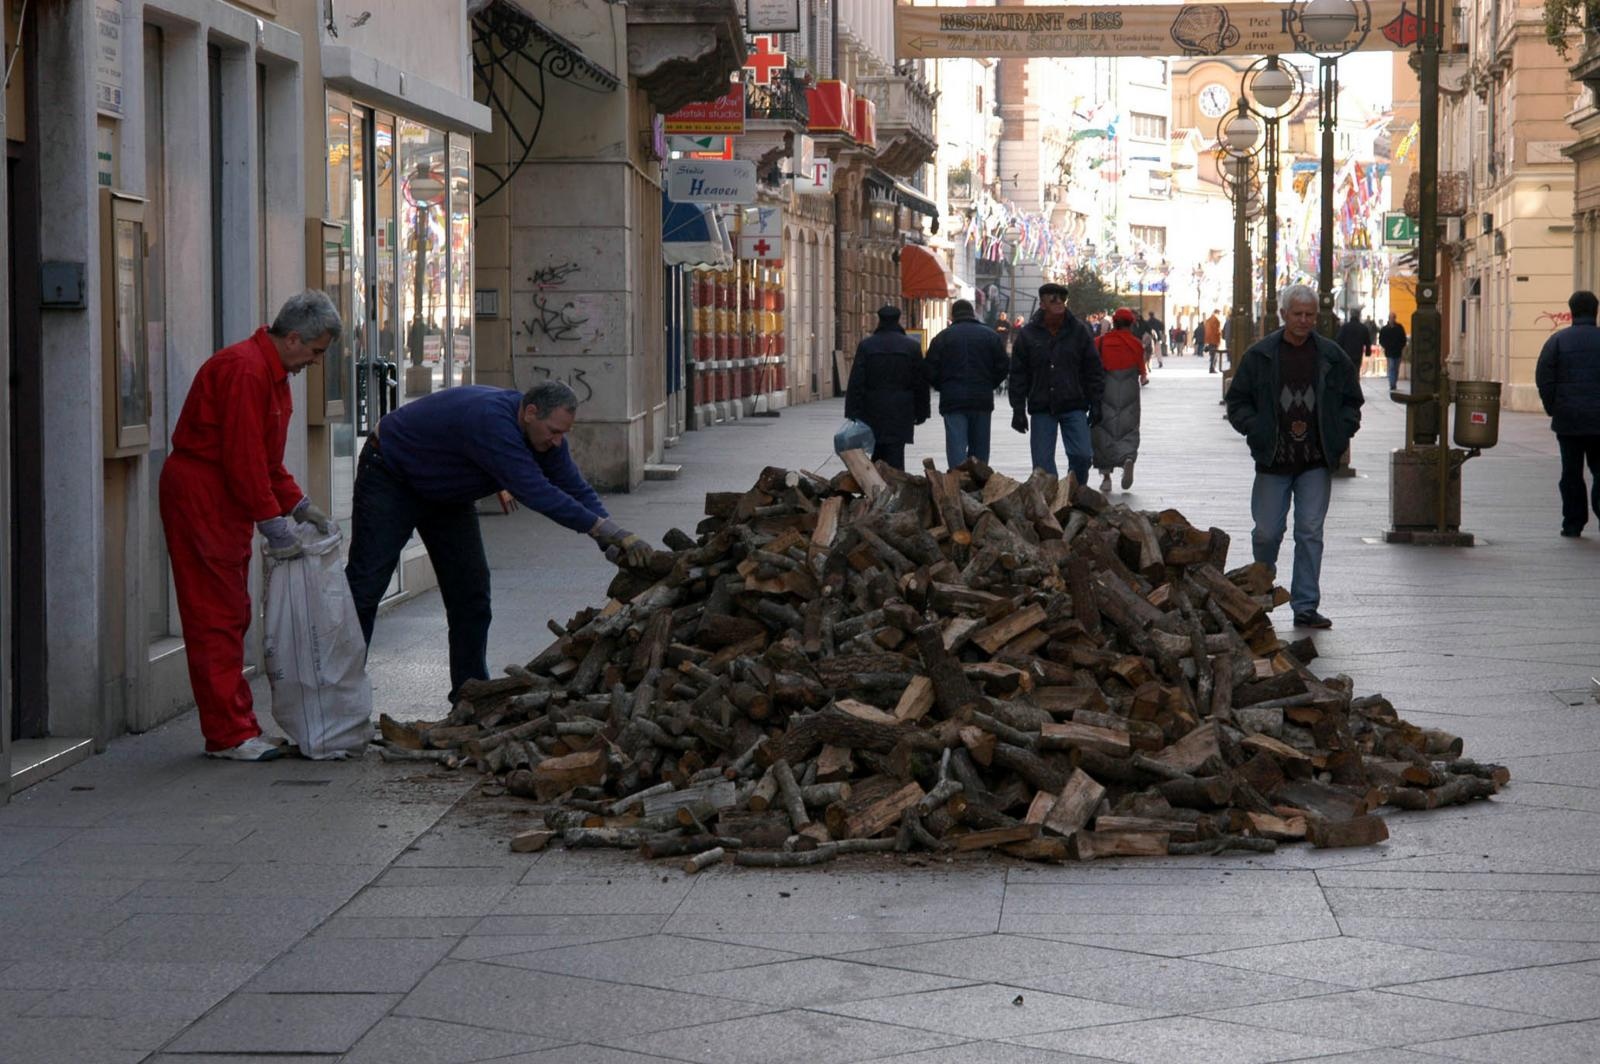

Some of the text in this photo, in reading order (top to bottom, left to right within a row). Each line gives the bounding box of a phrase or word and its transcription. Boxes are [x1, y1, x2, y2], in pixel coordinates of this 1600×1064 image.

[1067, 12, 1087, 30] od
[946, 34, 1019, 50] ZLATNA
[1244, 40, 1275, 51] drva
[708, 110, 741, 118] studio
[676, 165, 704, 175] Studio
[688, 178, 738, 196] Heaven
